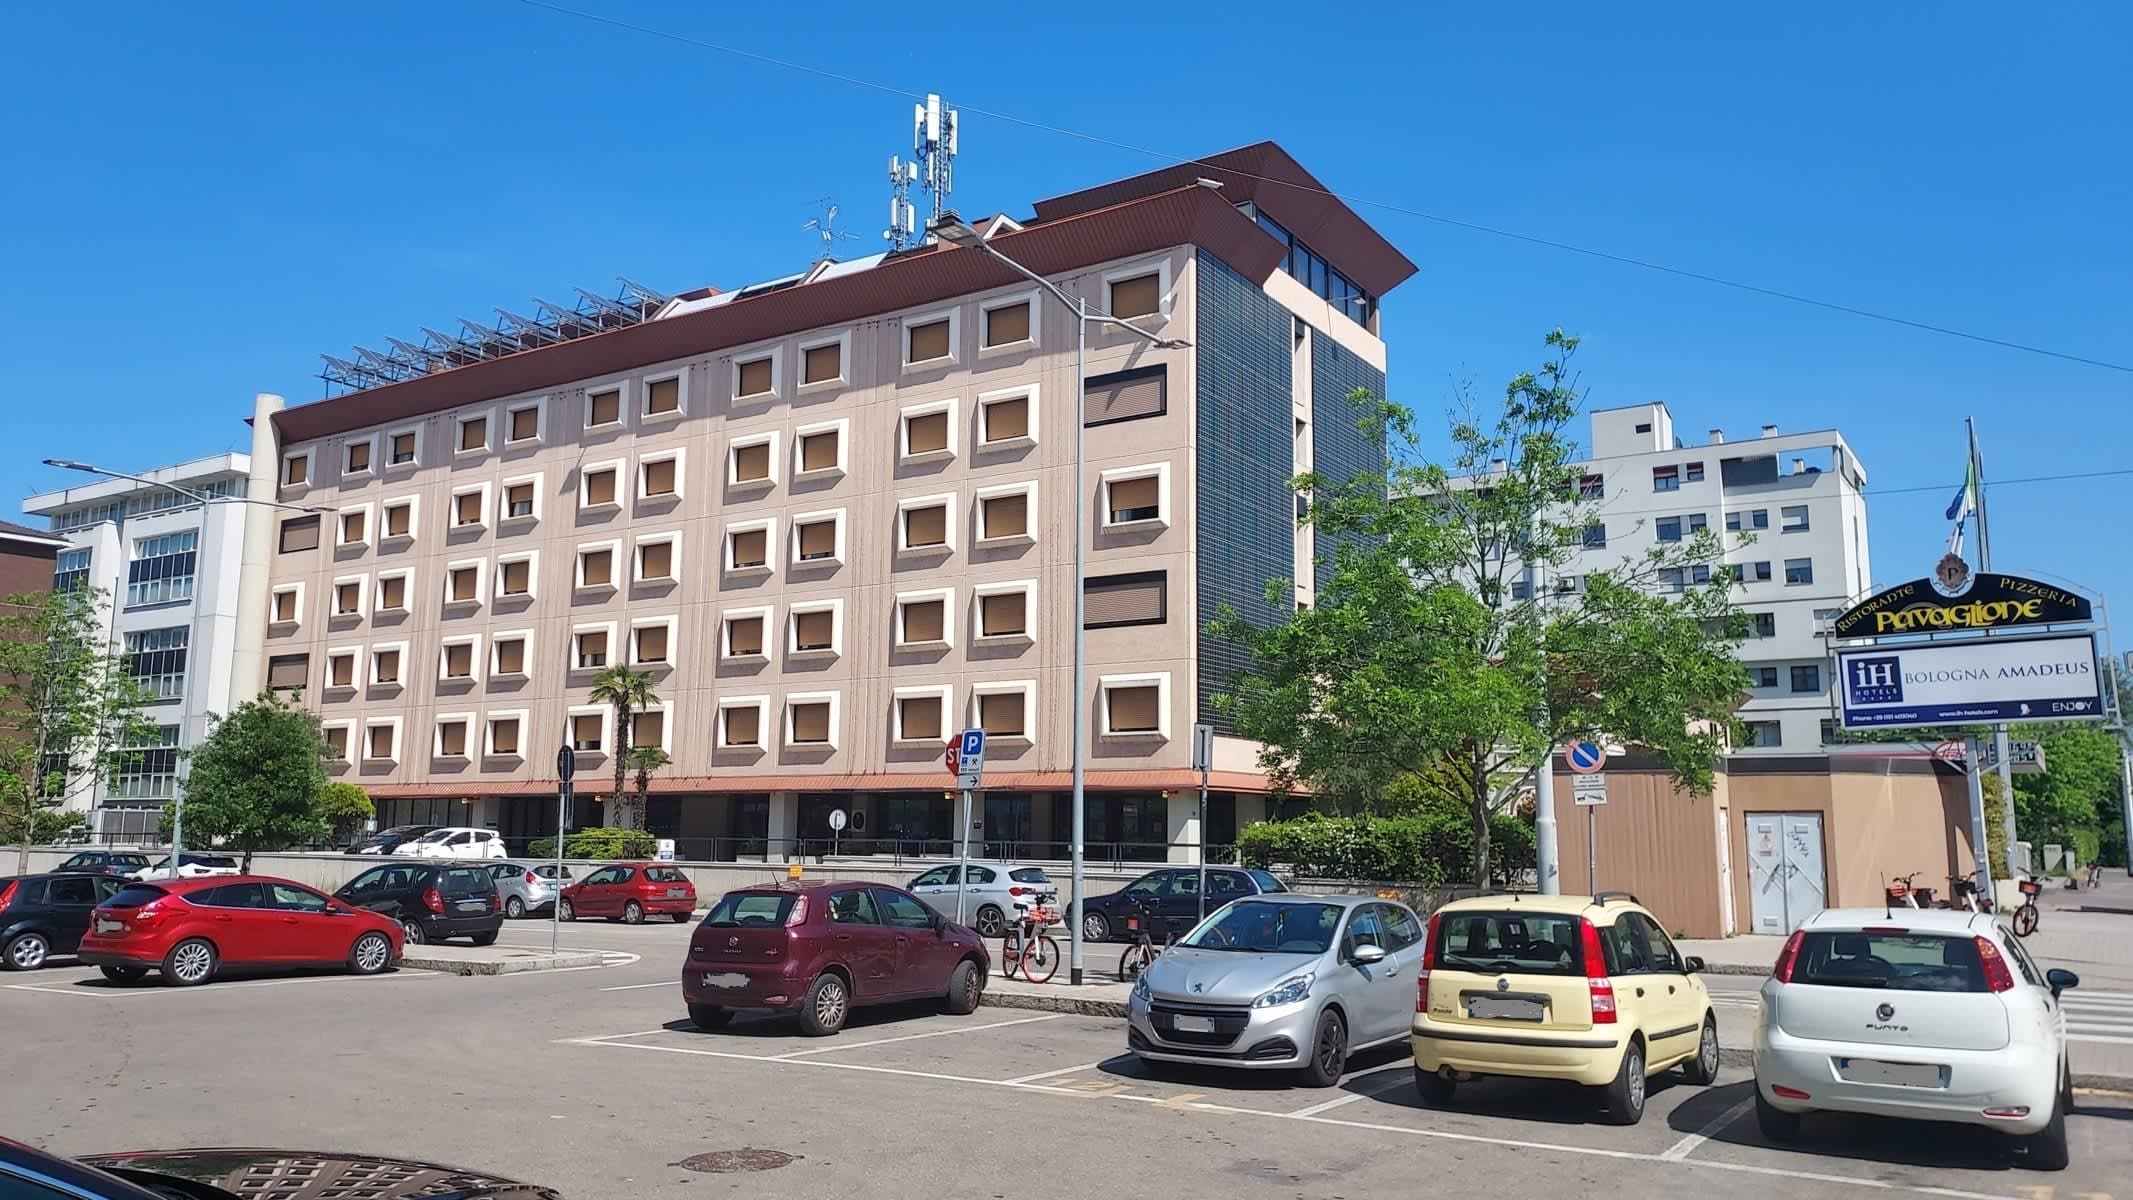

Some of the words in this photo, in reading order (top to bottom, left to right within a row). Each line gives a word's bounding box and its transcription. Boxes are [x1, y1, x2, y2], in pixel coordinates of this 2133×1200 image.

[1837, 585, 1914, 632] RISTORANTE
[2000, 577, 2078, 608] PIZZERIA
[1905, 668, 1990, 684] BOLOGNA
[1998, 661, 2089, 680] AMADEUS
[1855, 687, 1898, 697] HOTELS
[2051, 700, 2093, 713] ENJOY
[968, 736, 979, 751] P
[947, 748, 960, 763] ST
